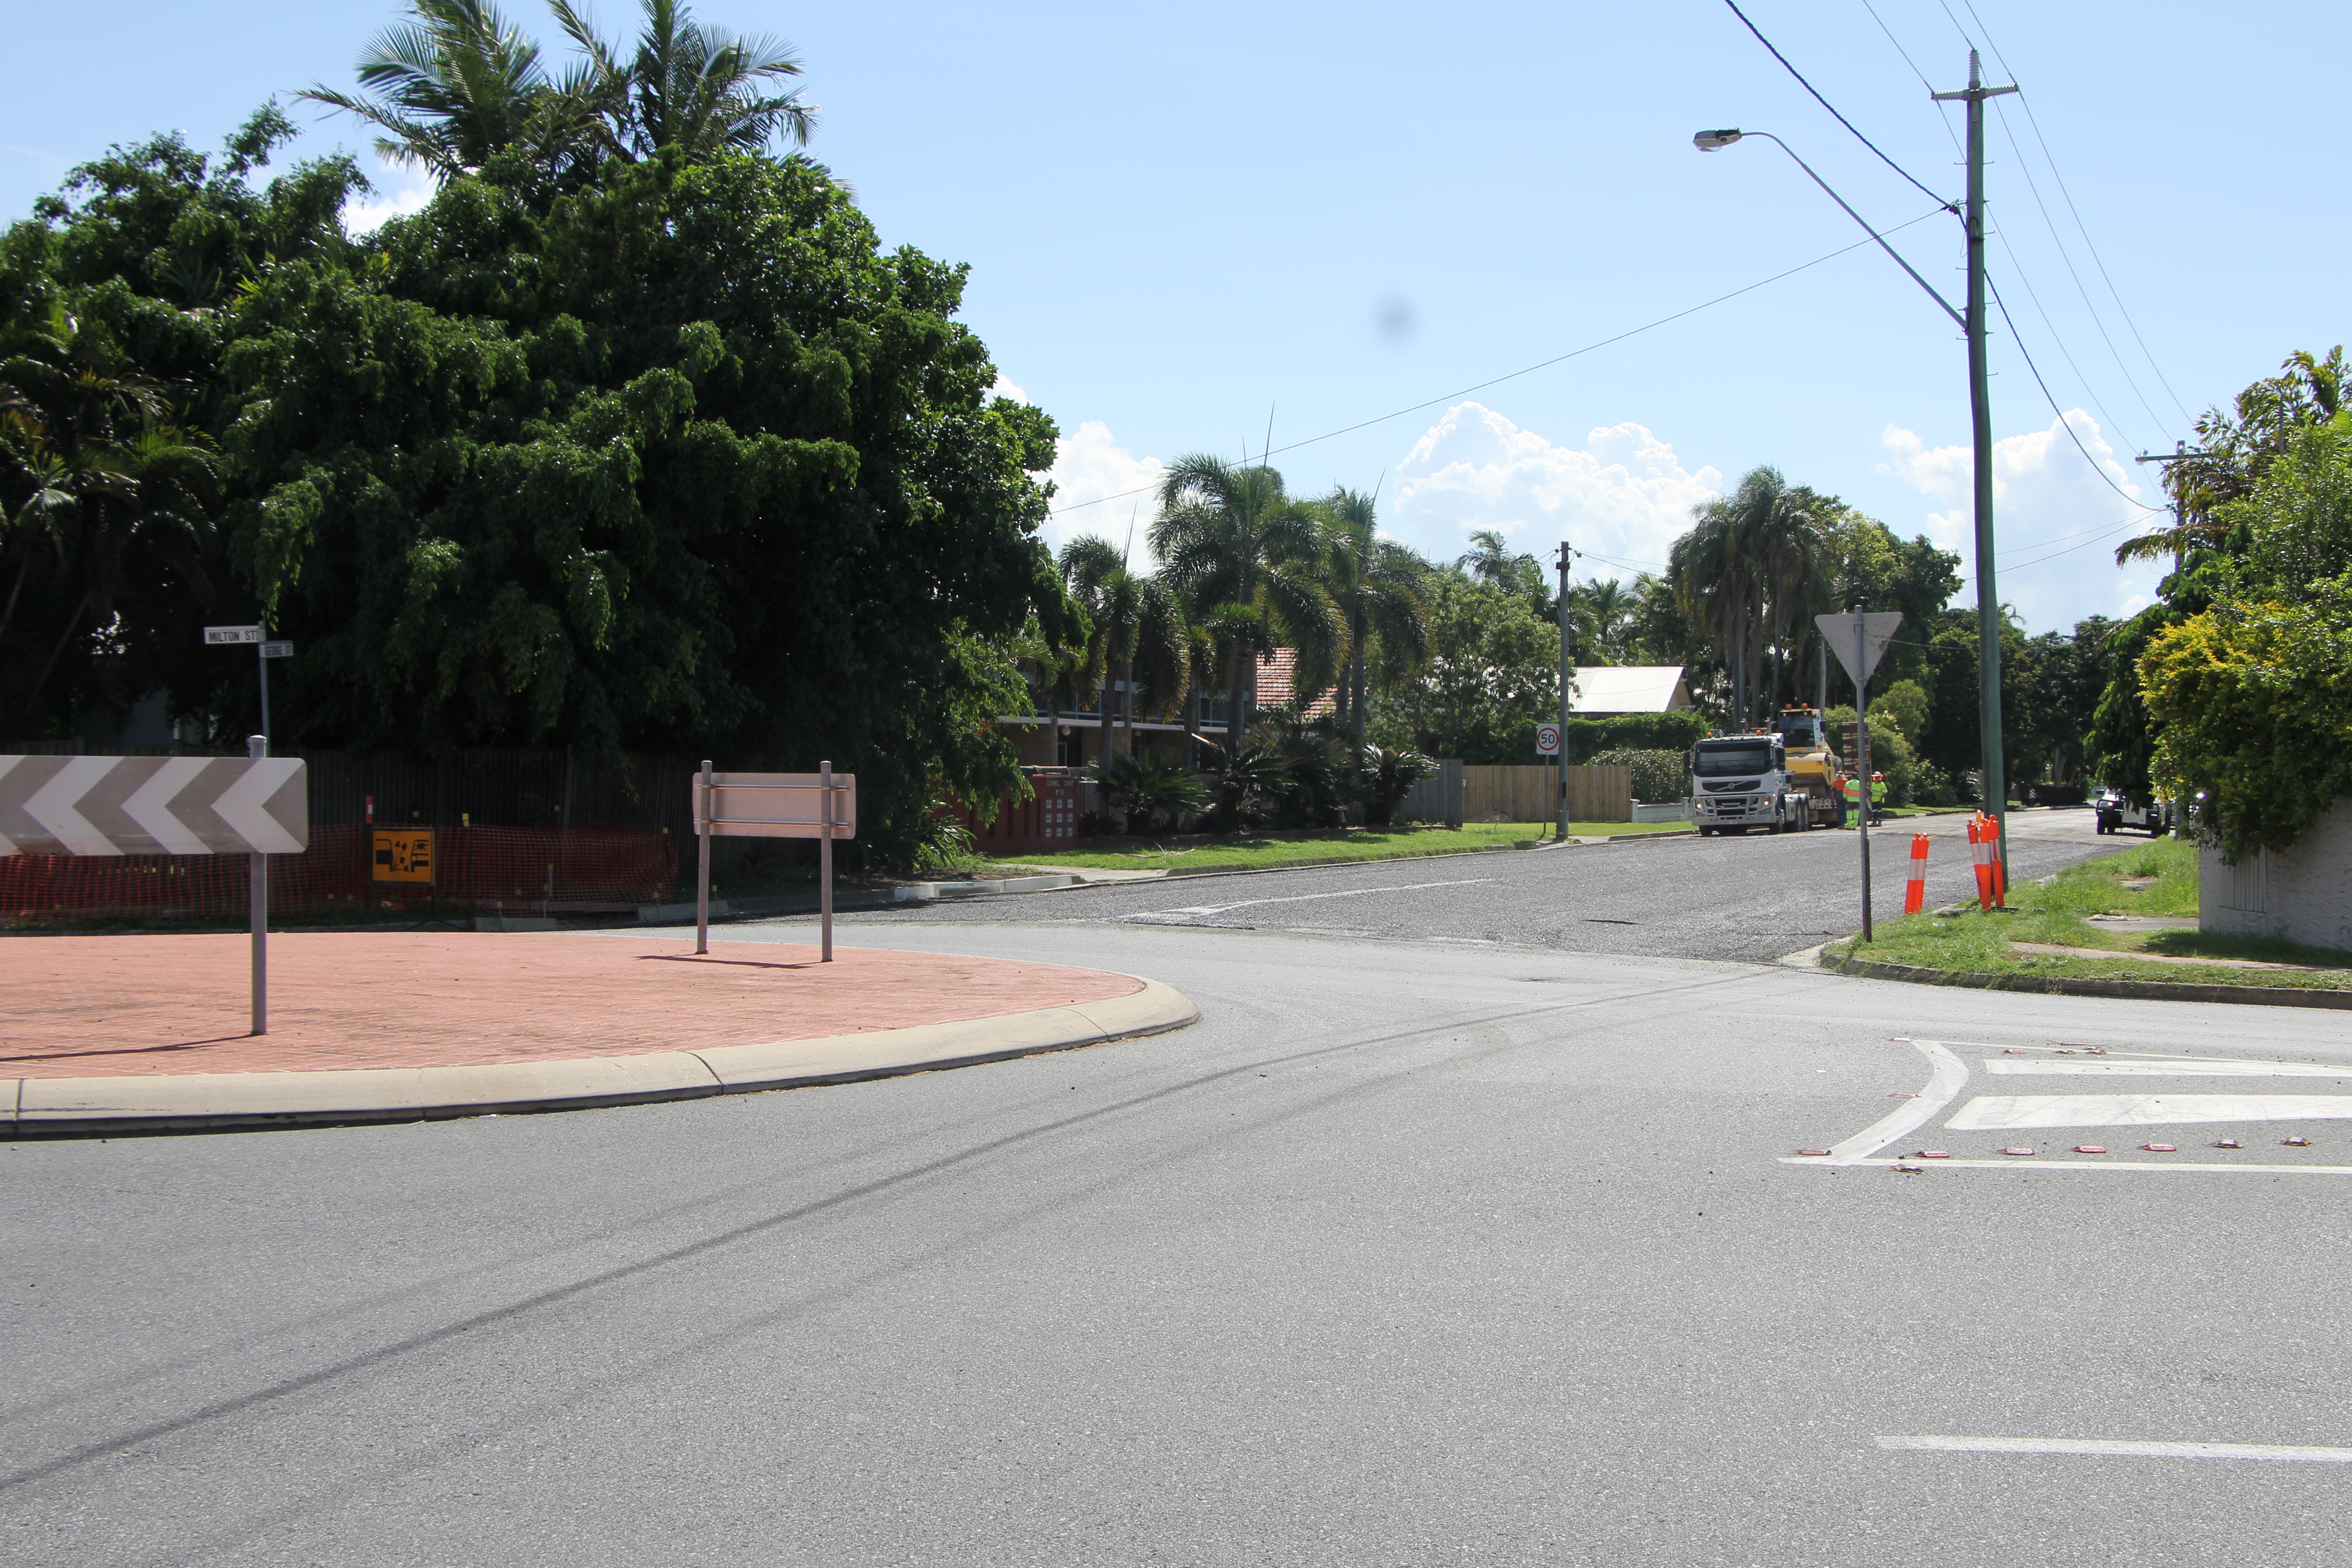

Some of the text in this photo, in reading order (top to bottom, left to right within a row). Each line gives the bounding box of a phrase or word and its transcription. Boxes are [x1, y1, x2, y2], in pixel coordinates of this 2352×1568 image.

[209, 631, 255, 642] MILTON ST
[1541, 734, 1555, 744] 50
